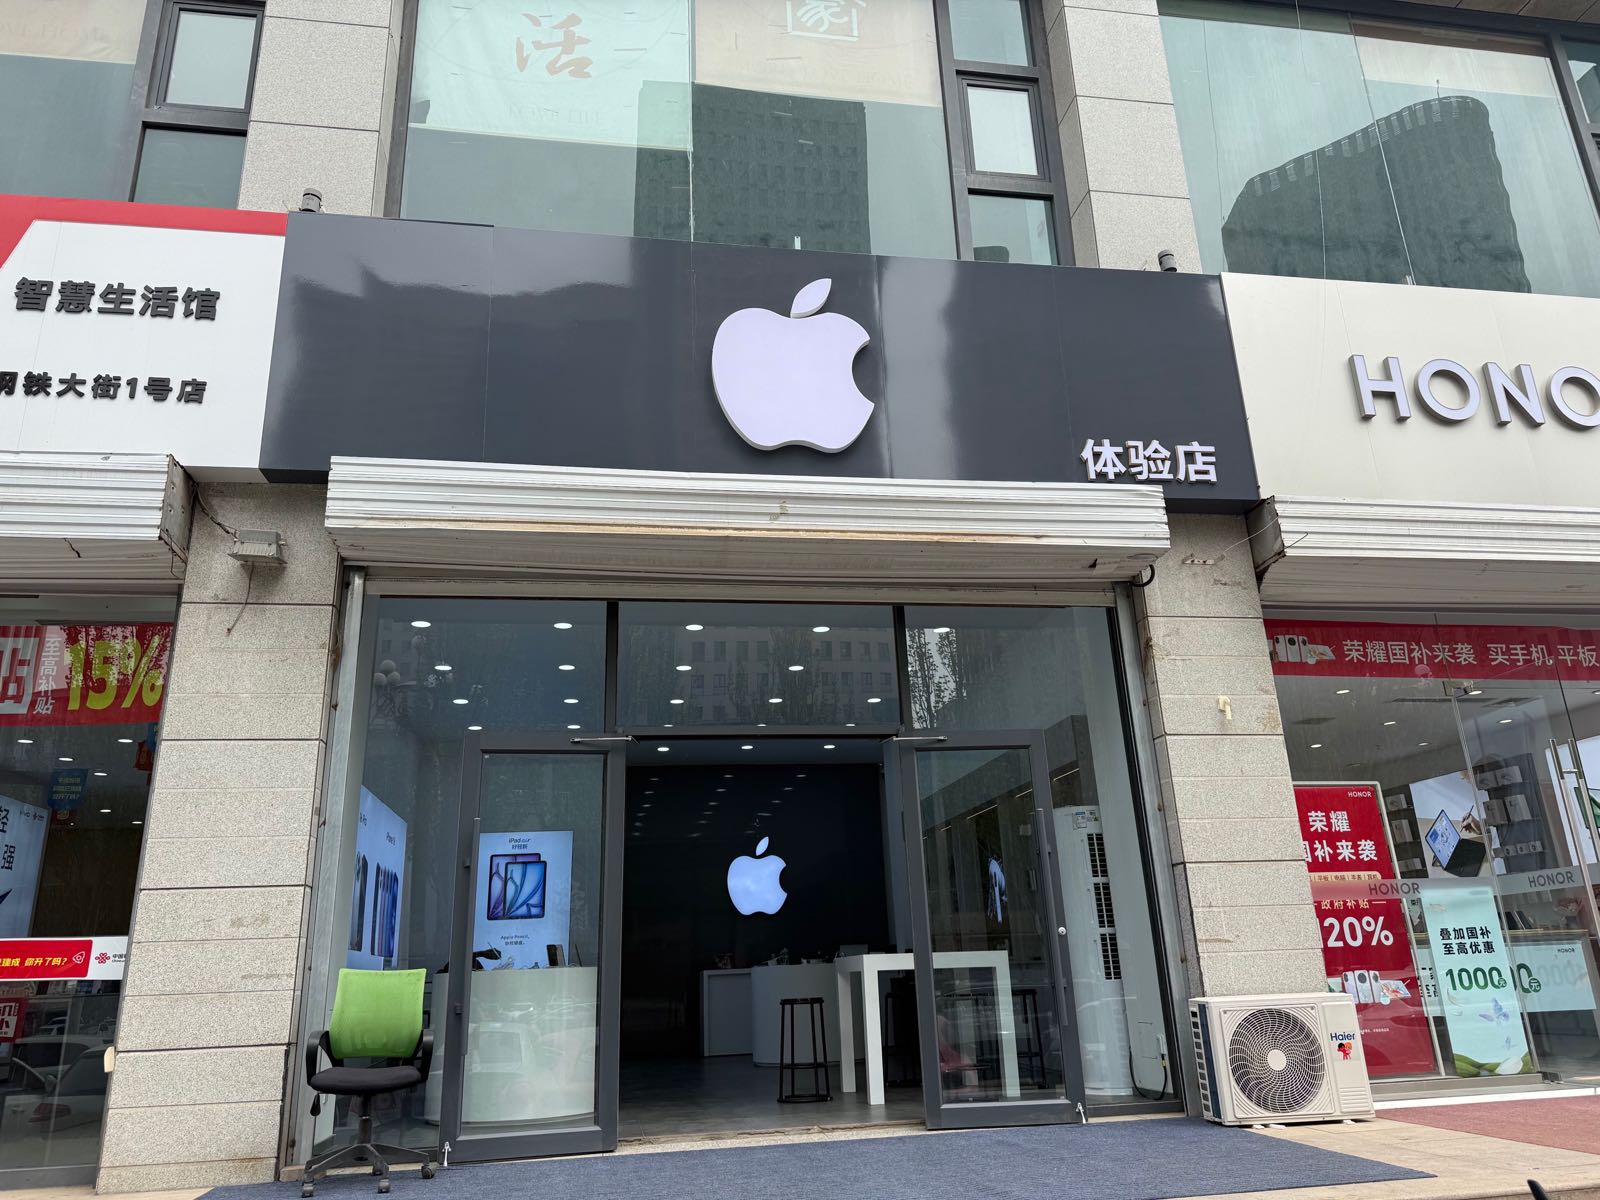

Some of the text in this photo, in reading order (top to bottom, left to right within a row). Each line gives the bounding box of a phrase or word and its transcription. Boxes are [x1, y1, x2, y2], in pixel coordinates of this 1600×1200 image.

[515, 12, 594, 79] 活
[14, 276, 221, 321] 智慧生活馆
[1080, 438, 1218, 483] 体验店
[1342, 640, 1477, 666] 荣耀国补来袭
[32, 636, 62, 715] 至高补贴
[63, 634, 165, 711] 15%
[1307, 810, 1351, 833] 荣耀
[1, 843, 16, 872] 强
[1369, 881, 1420, 896] HONOR
[1528, 871, 1576, 888] HONOR
[1321, 899, 1370, 910] 政府补贴
[1440, 926, 1492, 941] 叠加国补
[1442, 941, 1496, 956] 至高优惠
[1330, 1031, 1356, 1042] Haier
